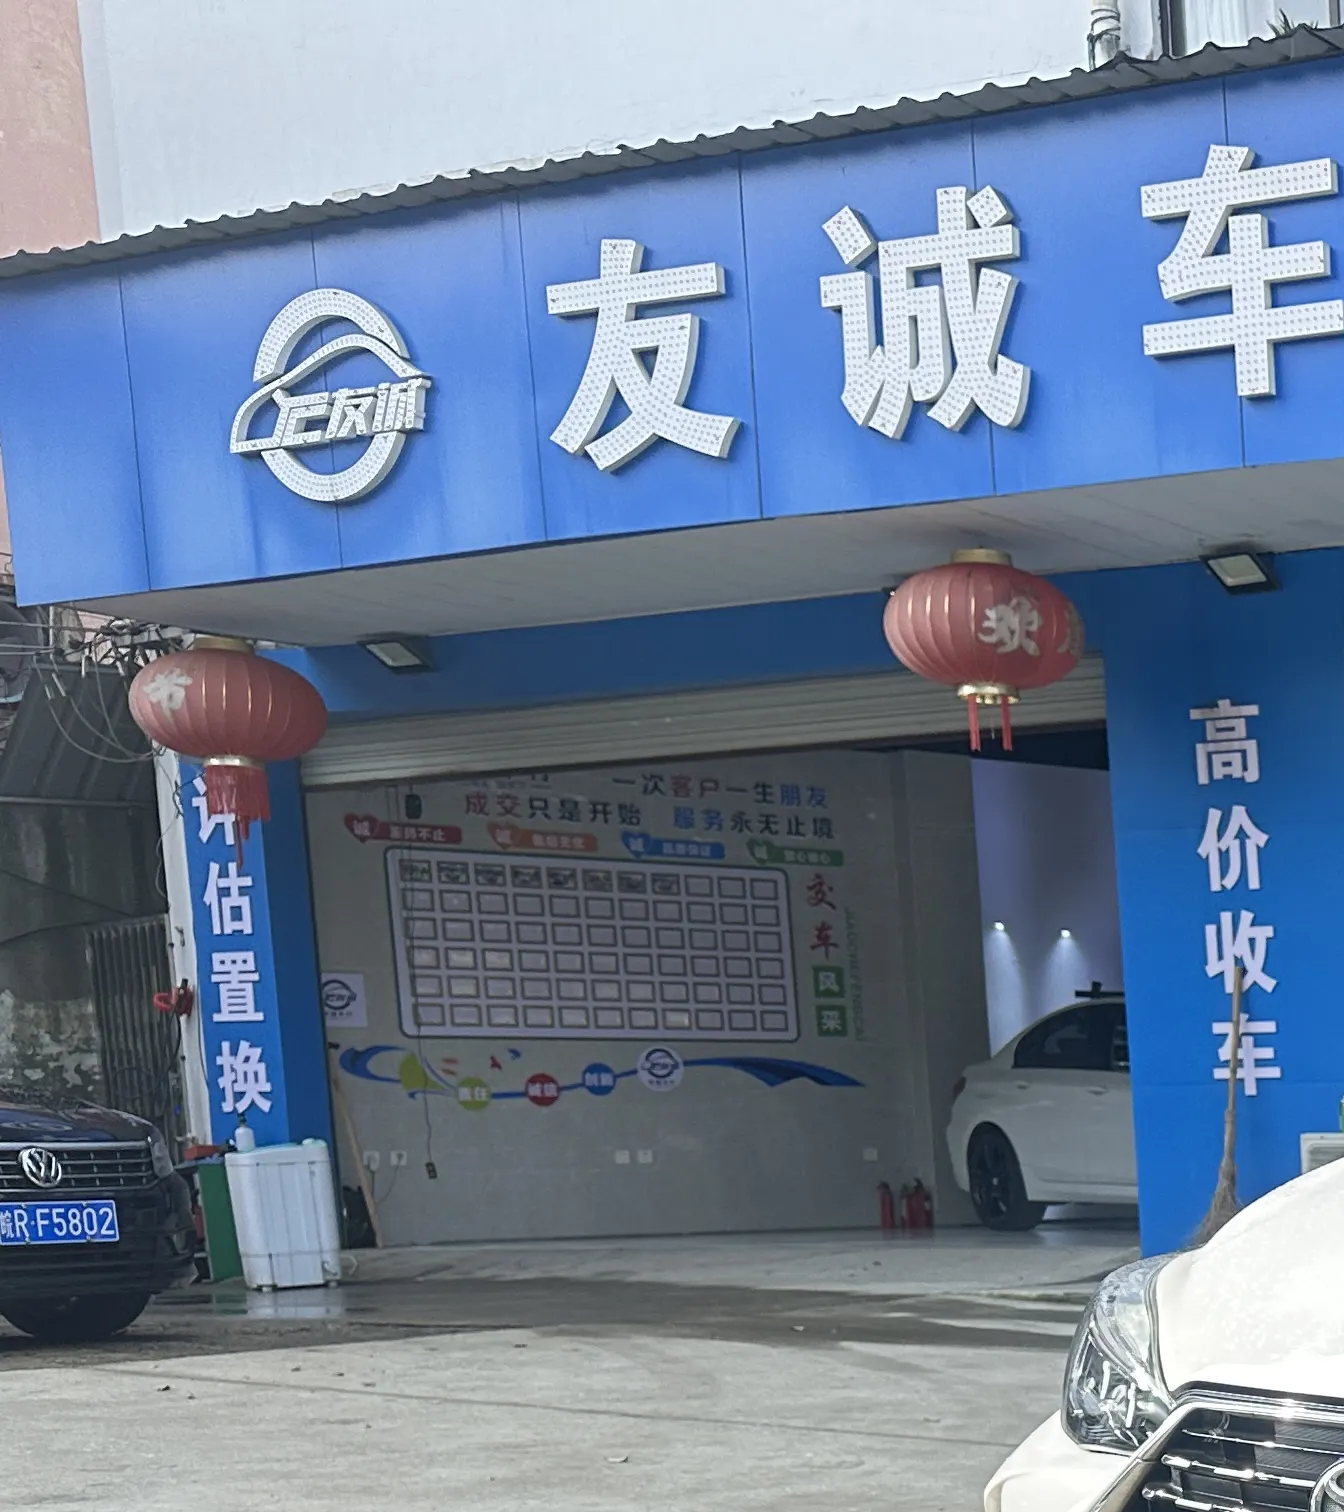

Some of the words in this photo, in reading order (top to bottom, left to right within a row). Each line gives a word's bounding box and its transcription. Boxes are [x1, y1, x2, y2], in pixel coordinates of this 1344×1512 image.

[464, 790, 642, 827] 成交只是开始
[673, 805, 835, 840] 服务永无止境
[612, 772, 829, 809] 一次客户一生朋友
[1188, 698, 1282, 1096] 高价收车
